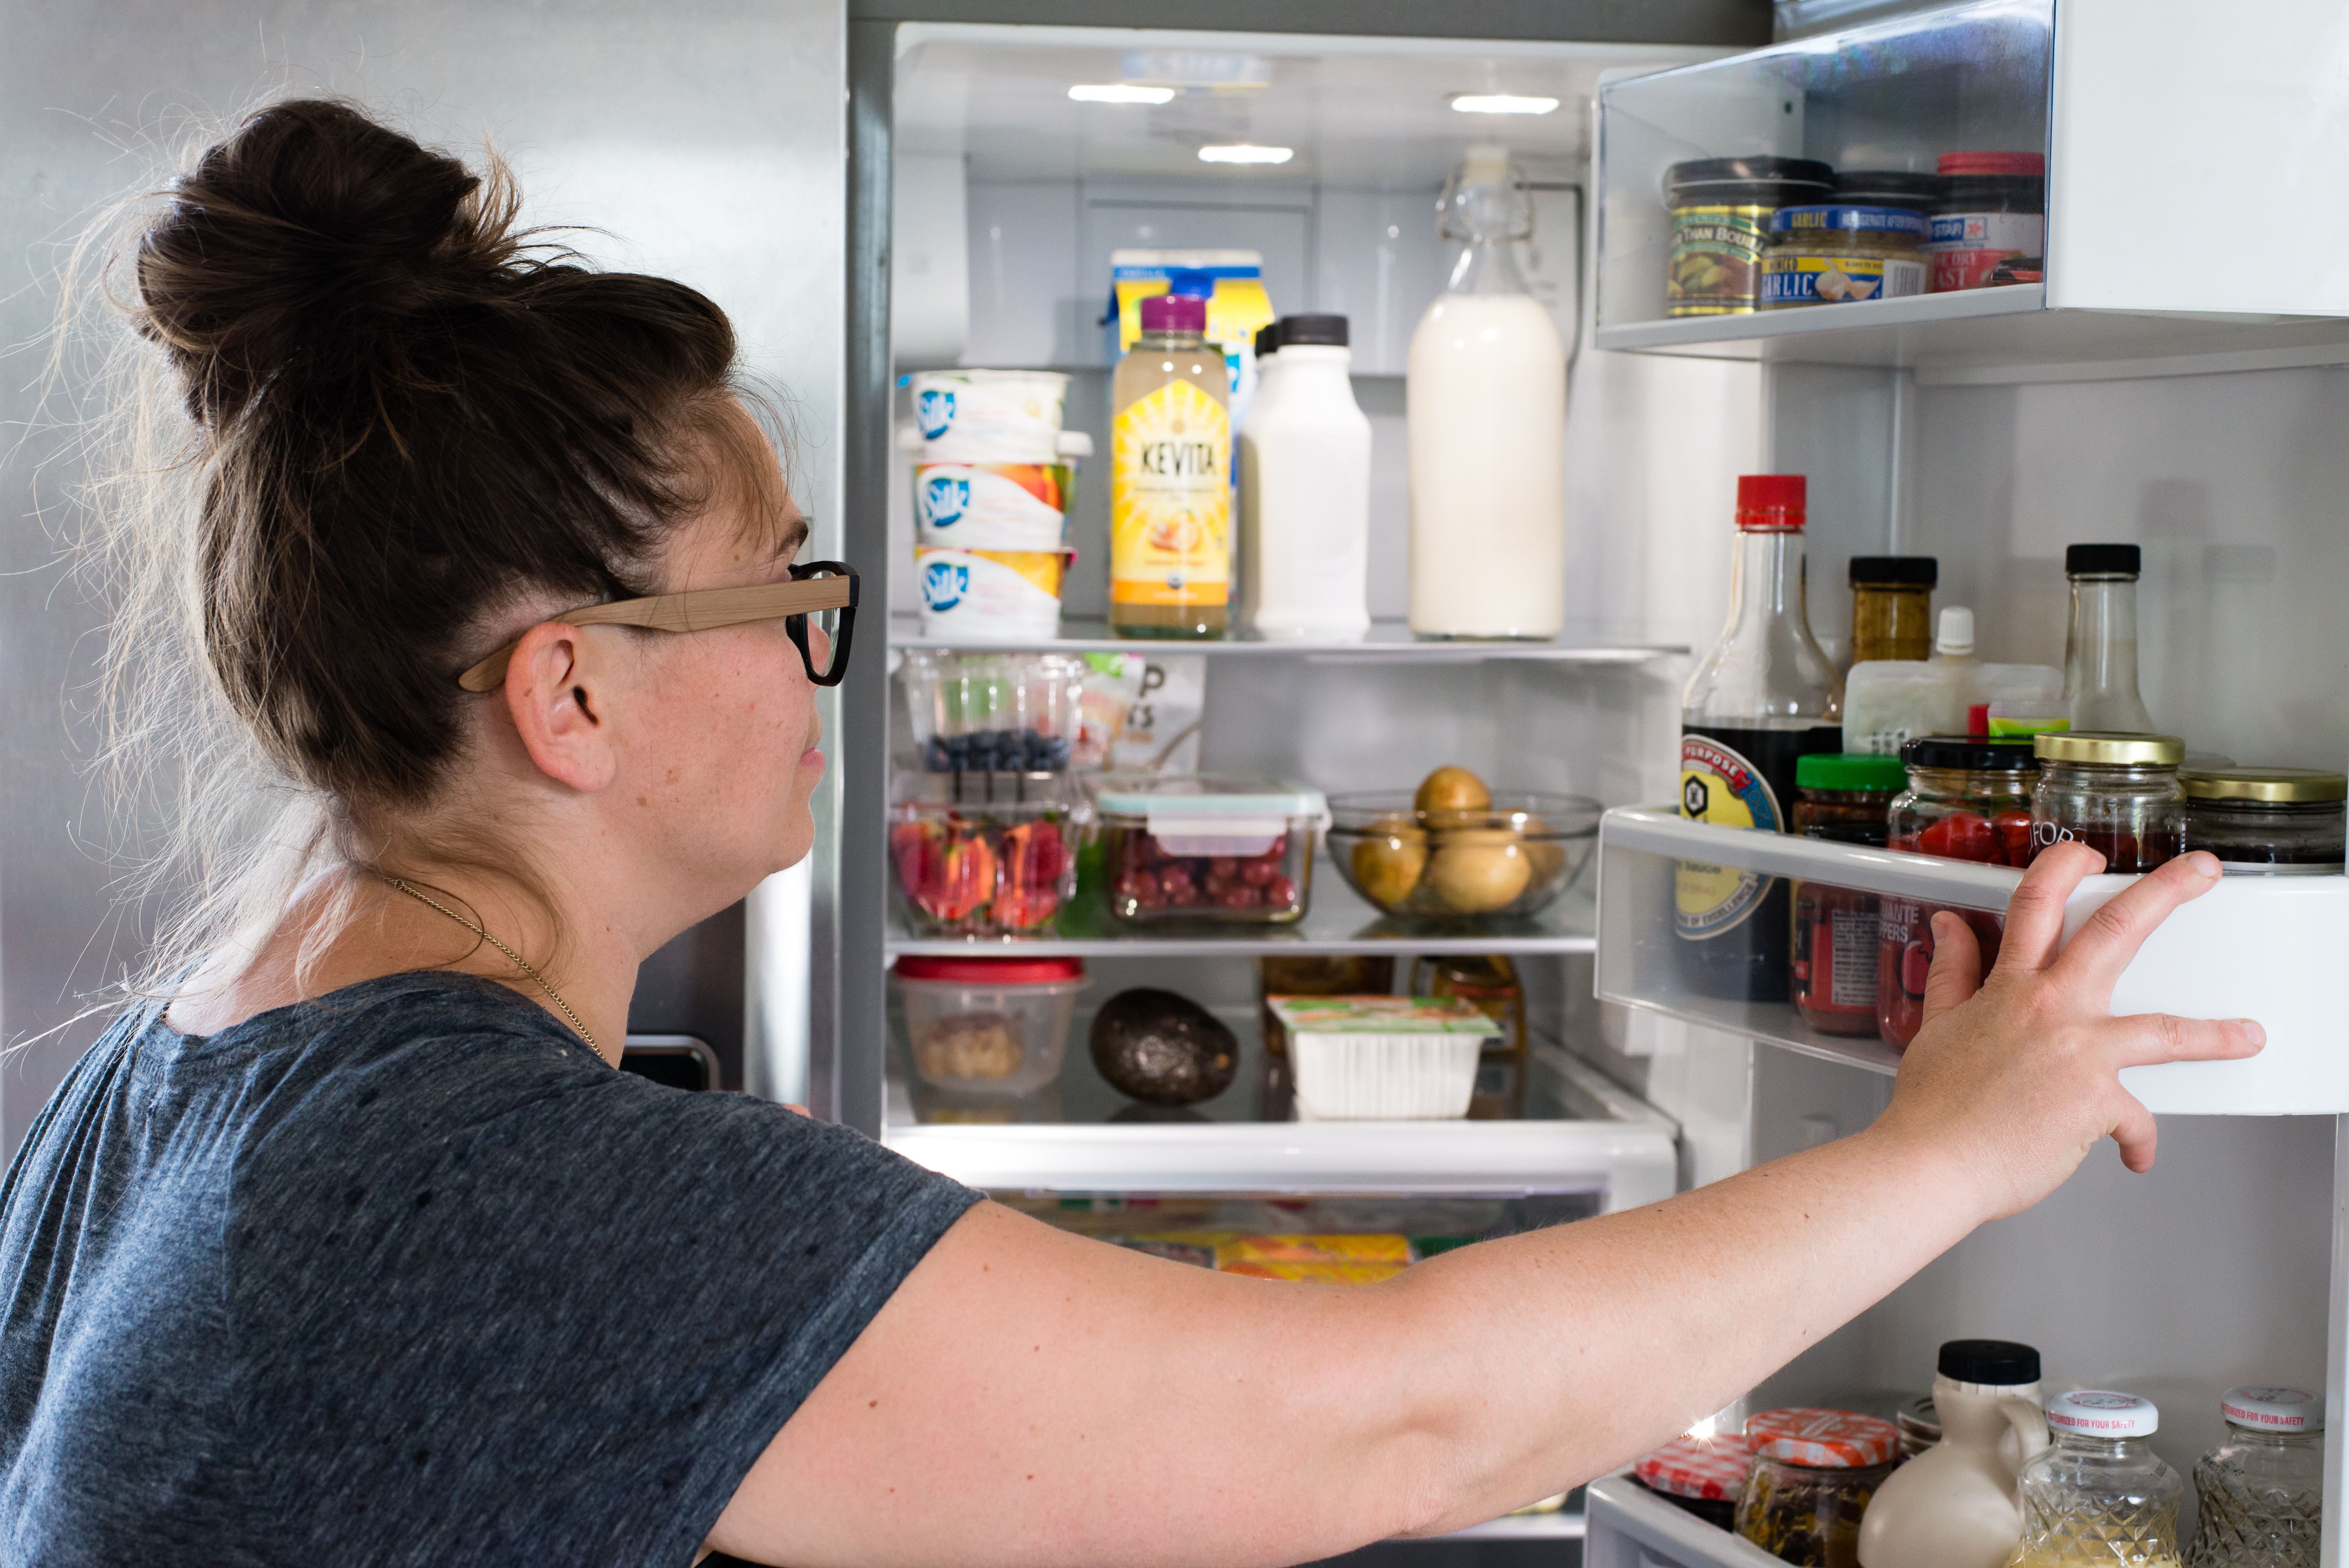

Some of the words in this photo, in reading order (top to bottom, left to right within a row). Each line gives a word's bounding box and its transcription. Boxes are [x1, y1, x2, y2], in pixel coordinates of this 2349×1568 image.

[1791, 212, 1827, 228] GARLIC
[1716, 226, 1764, 253] BOUILL
[1141, 441, 1217, 475] KEVITA
[2076, 1418, 2089, 1428] FOR
[2091, 1420, 2109, 1429] YOUR
[2111, 1420, 2135, 1429] SAFETY
[2246, 1412, 2258, 1421] FOR
[2260, 1414, 2278, 1424] YOUR
[2280, 1417, 2304, 1425] SAFETY
